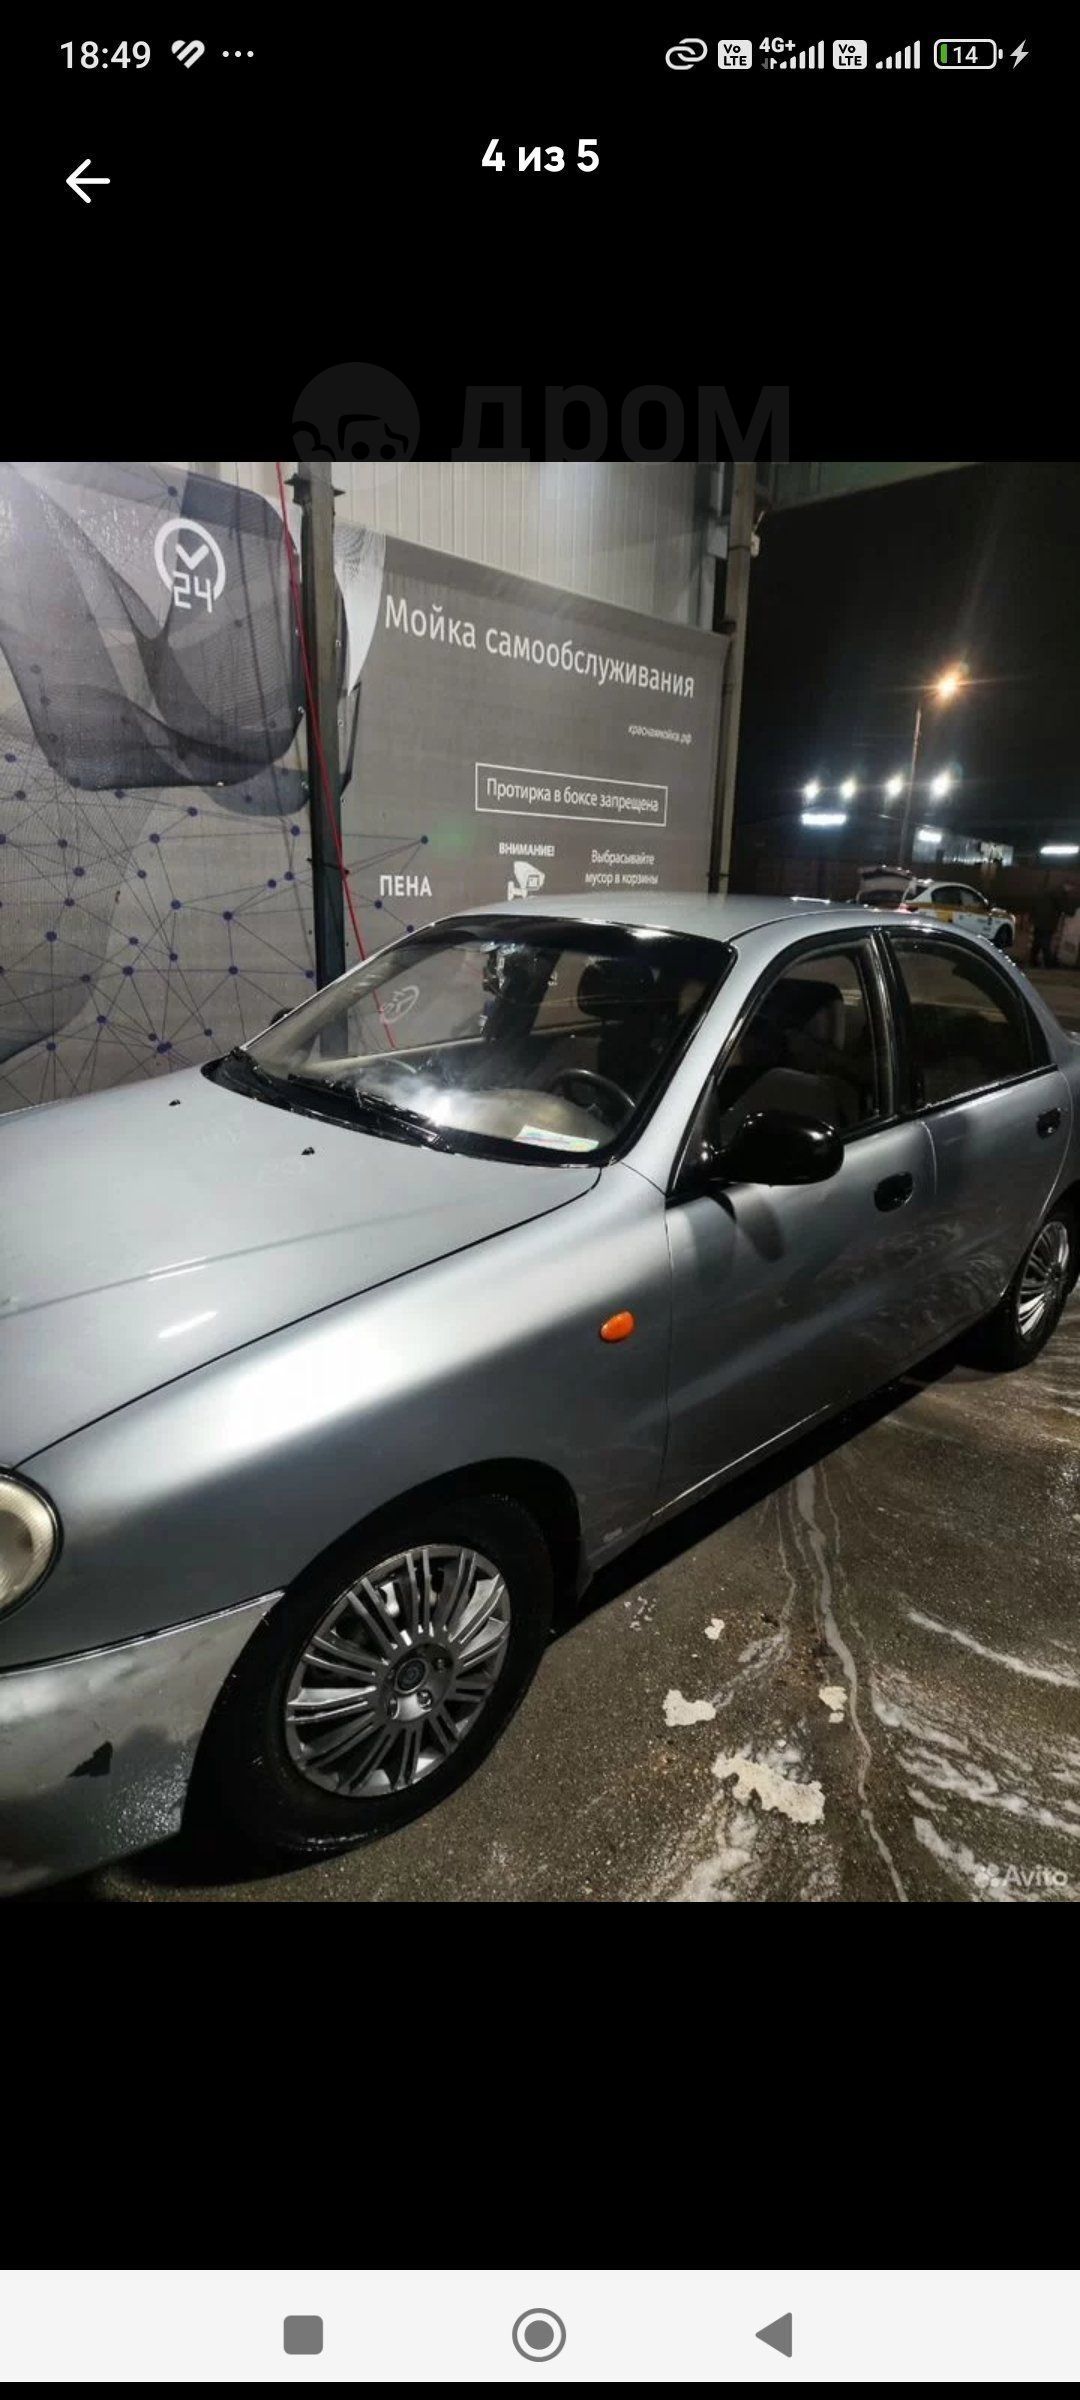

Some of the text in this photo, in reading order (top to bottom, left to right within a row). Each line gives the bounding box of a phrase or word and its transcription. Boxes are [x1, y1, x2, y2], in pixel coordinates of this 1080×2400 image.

[173, 570, 213, 613] 24
[385, 595, 695, 698] Мойка самообслуживания
[486, 777, 660, 814] Протирка в боксе запрещена
[499, 842, 555, 857] ВНИМАНИЕ!
[591, 849, 655, 866] Выбрасывайте
[380, 874, 433, 898] ПЕНА
[585, 873, 613, 887] мусор
[622, 874, 659, 887] корзины
